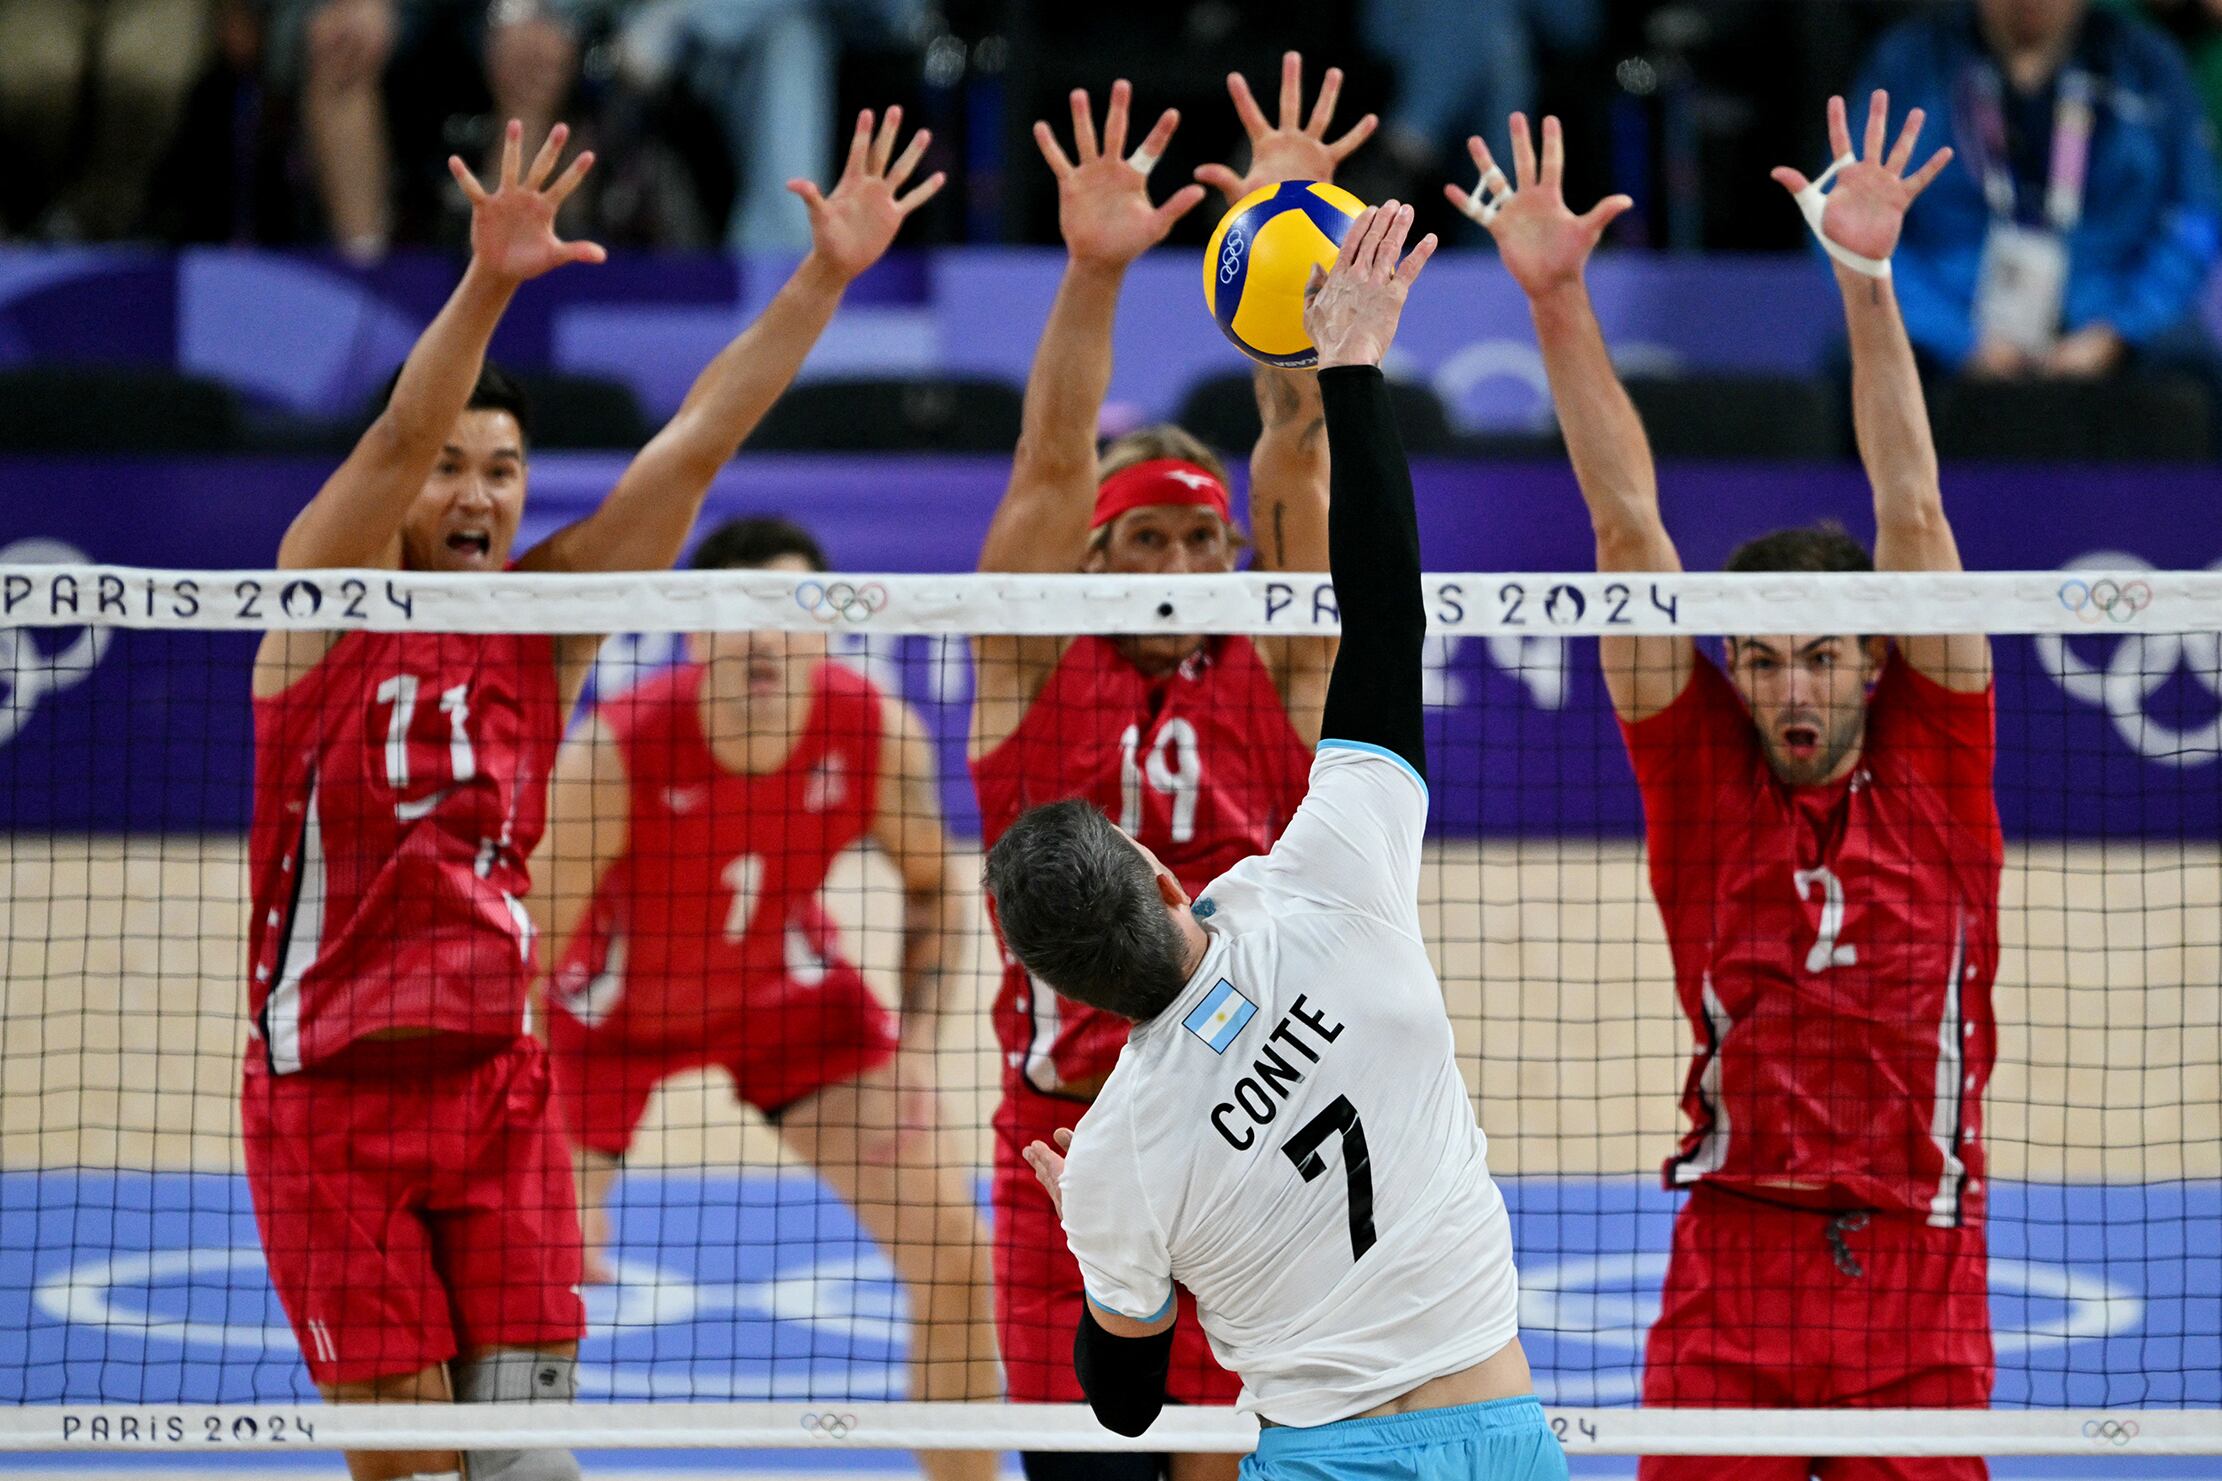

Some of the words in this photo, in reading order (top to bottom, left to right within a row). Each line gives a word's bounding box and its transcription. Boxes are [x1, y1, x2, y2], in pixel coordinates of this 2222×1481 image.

[234, 579, 412, 620] 2024
[1266, 583, 1464, 624] PAS
[1500, 583, 1678, 625] 2024
[376, 673, 477, 790] 11
[1119, 716, 1200, 842] 19
[720, 851, 765, 945] 1
[1793, 865, 1858, 973] 2
[1210, 993, 1345, 1151] CONTE
[1281, 1094, 1377, 1263] 7
[204, 1416, 315, 1442] 2024
[1551, 1417, 1596, 1442] 24
